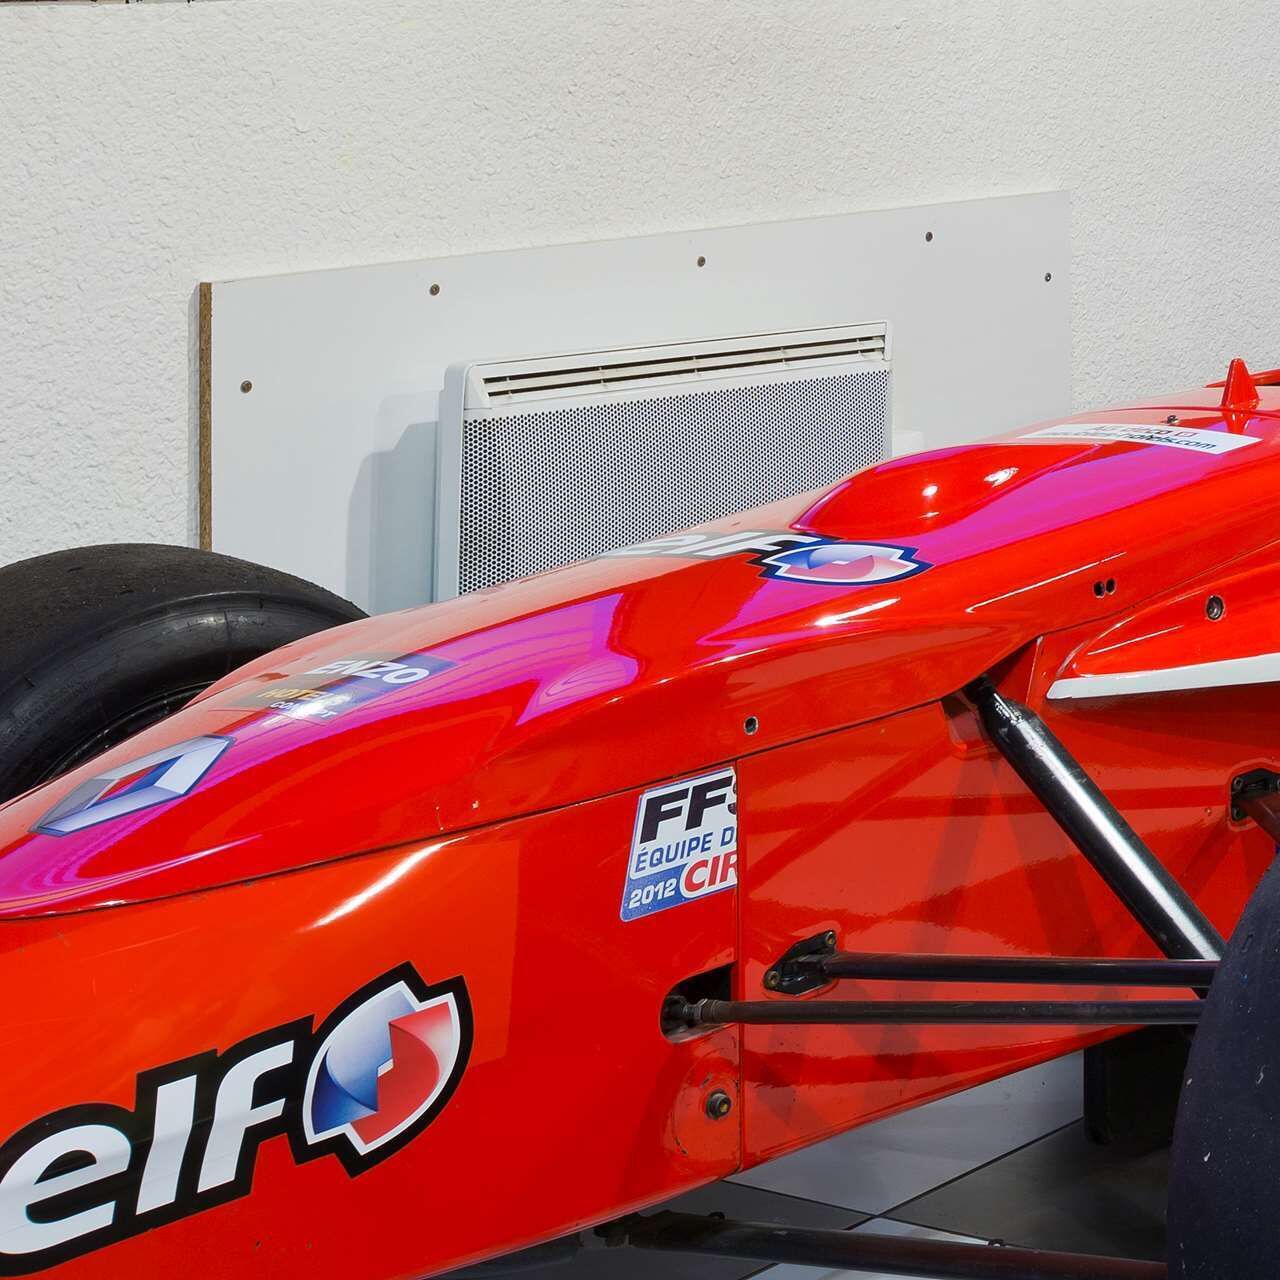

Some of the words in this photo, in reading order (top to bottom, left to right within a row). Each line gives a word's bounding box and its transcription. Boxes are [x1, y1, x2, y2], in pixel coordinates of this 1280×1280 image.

[303, 660, 430, 684] ENZO
[635, 832, 714, 872] ÉQUIPE
[720, 825, 737, 846] D
[628, 878, 678, 909] 2012
[684, 849, 738, 893] CIR
[0, 1040, 295, 1255] elf
